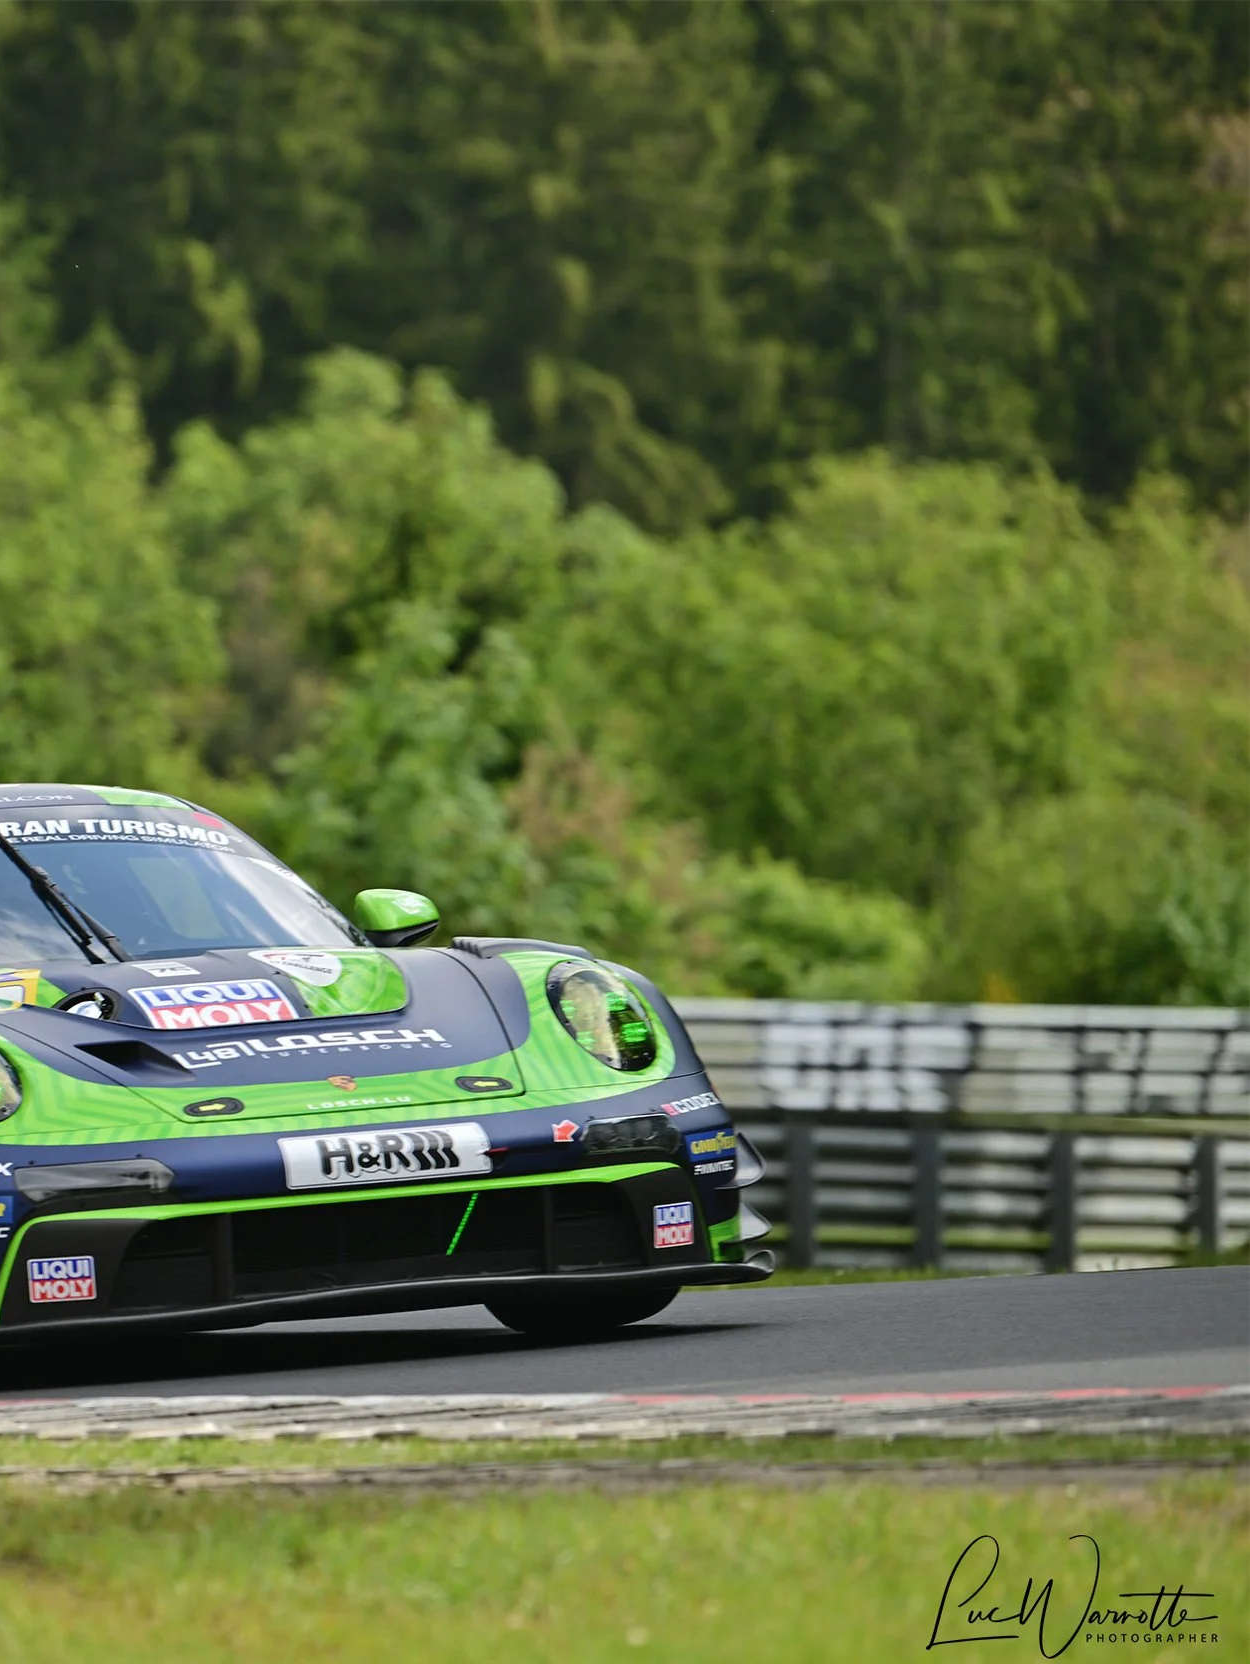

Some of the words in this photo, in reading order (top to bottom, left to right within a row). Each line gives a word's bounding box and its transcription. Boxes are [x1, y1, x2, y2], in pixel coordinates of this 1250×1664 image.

[78, 819, 231, 846] TURISMO
[142, 982, 278, 1007] LIQUI
[158, 1000, 283, 1029] MOLY
[246, 1029, 447, 1052] LOSCH
[261, 1042, 453, 1059] LUXEMBOURG
[306, 1096, 412, 1110] LOSCH.LU
[656, 1205, 691, 1226] LIQUI
[657, 1223, 692, 1245] MOLY
[31, 1259, 90, 1280] LIQUI
[32, 1278, 94, 1300] MOLY
